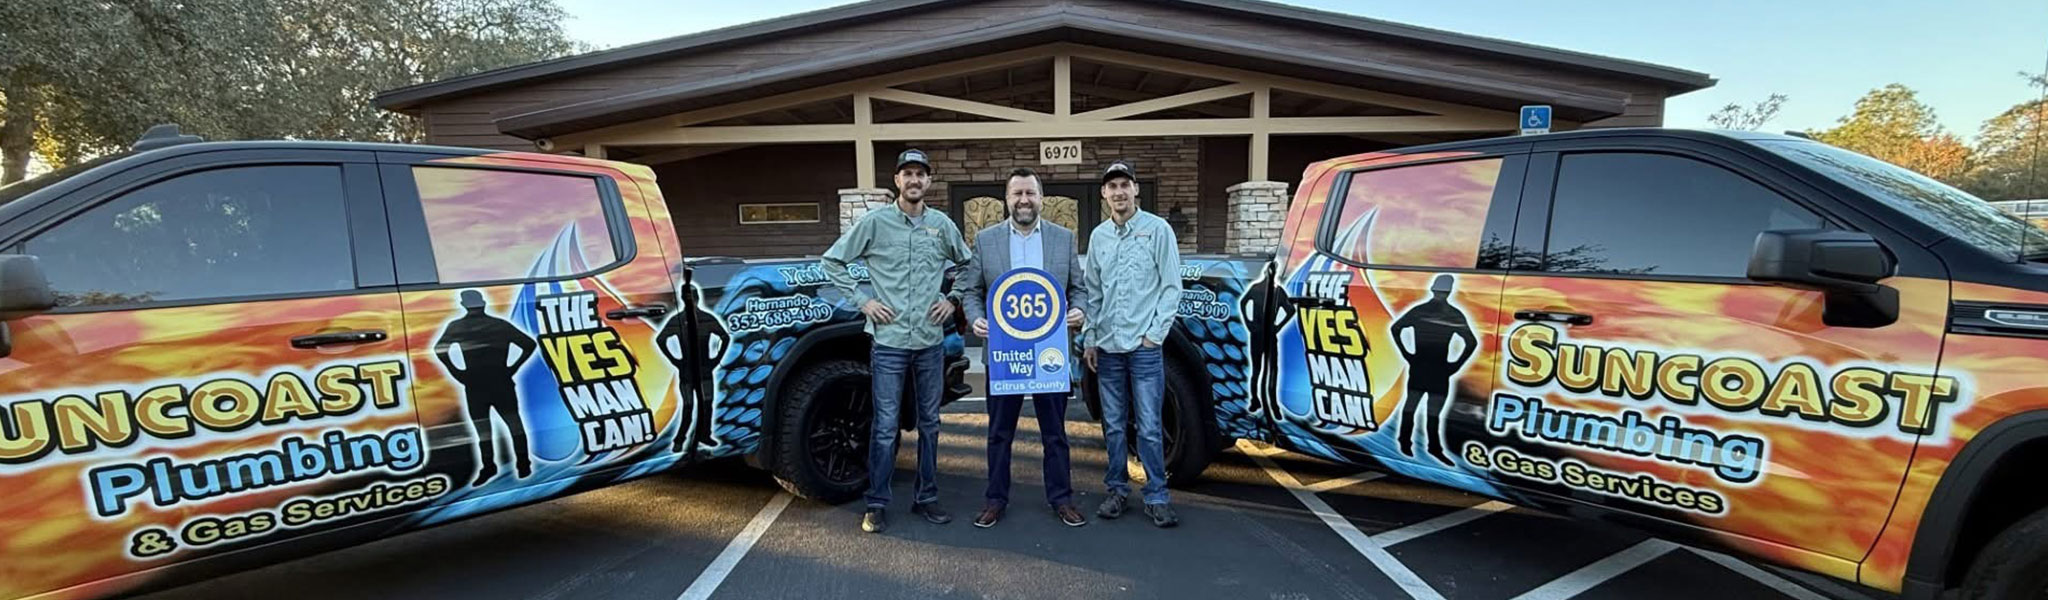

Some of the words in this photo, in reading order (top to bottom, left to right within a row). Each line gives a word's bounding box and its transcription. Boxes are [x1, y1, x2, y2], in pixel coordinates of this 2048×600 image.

[1044, 145, 1078, 160] 6970
[1180, 265, 1202, 278] net
[1308, 273, 1351, 306] THE
[540, 293, 599, 334] THE
[749, 296, 809, 312] Hernando
[1006, 293, 1048, 319] 365
[1179, 301, 1228, 318] 88-4909
[1182, 291, 1213, 301] nando
[730, 305, 831, 331] 352-688-4909
[1300, 307, 1363, 356] YES
[542, 331, 632, 383] YES
[992, 349, 1034, 361] United
[1009, 362, 1034, 377] Way
[1308, 353, 1367, 393] MAN
[994, 381, 1025, 391] Citrus
[1028, 380, 1065, 390] County
[1507, 323, 1957, 431] SUNCOAST
[0, 361, 403, 460] UNCOAST
[563, 378, 643, 419] MAN
[1315, 388, 1375, 429] CAN!
[583, 412, 654, 453] CAN!
[1493, 396, 1760, 479] Plumbing
[94, 427, 420, 514] Plumbing
[1468, 444, 1488, 466] &
[1495, 452, 1554, 480] Gas
[1565, 464, 1722, 513] Services
[134, 529, 173, 557] &
[187, 514, 272, 543] Gas
[285, 477, 446, 524] Services
